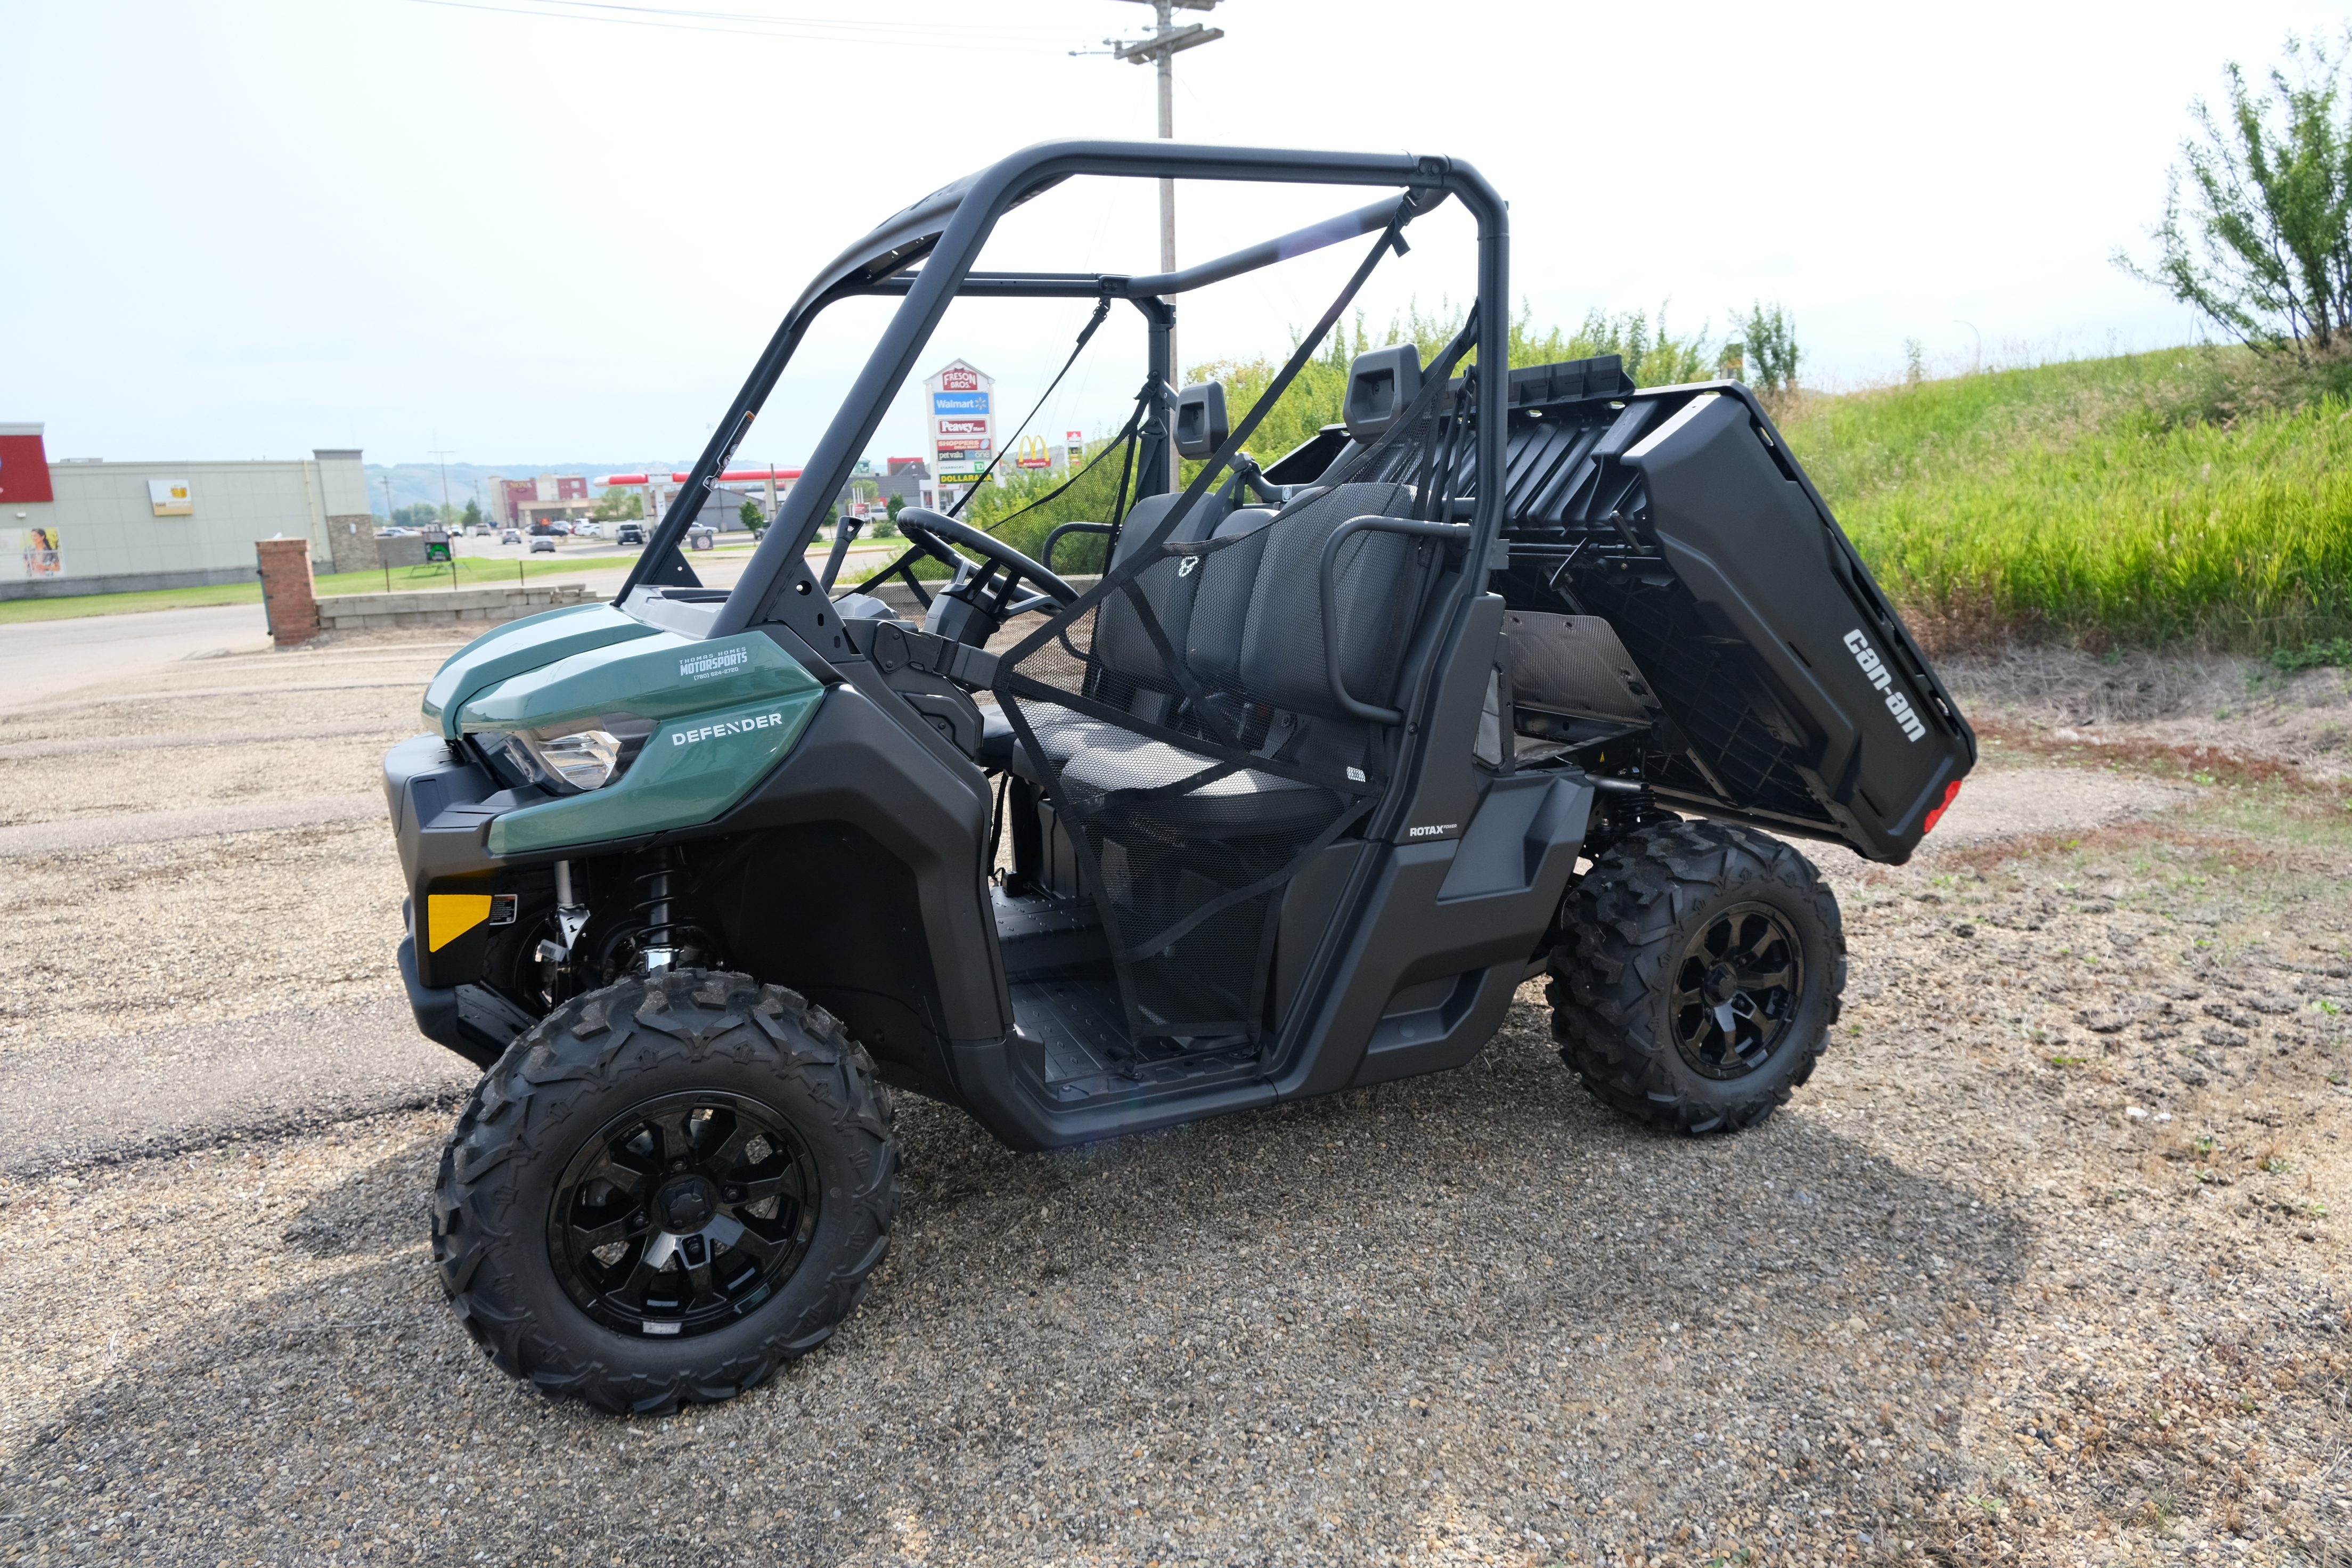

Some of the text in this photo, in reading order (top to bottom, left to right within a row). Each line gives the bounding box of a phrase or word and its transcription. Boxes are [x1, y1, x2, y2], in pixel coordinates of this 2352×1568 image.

[944, 372, 976, 385] FRESON
[936, 399, 974, 408] Walmart
[941, 421, 974, 432] Peavey
[679, 646, 746, 665] THOMAS HOMES
[680, 651, 747, 676] MOTORSPORTS
[672, 713, 782, 746] DEFENDER
[1410, 825, 1443, 836] ROTAX
